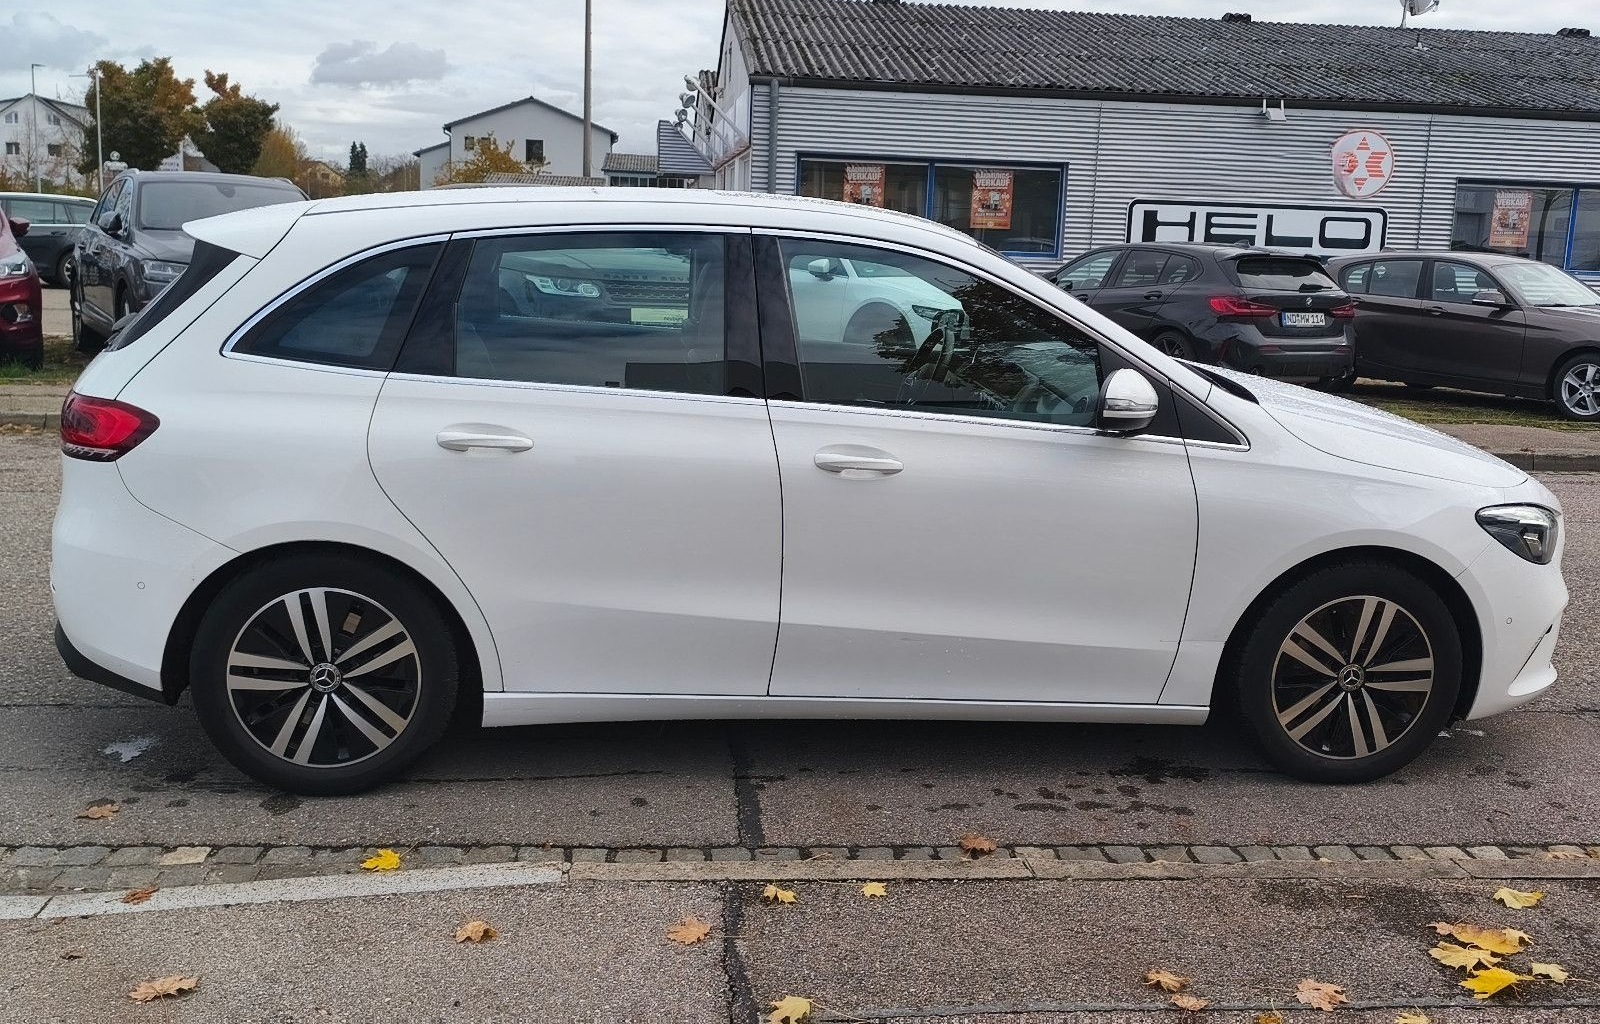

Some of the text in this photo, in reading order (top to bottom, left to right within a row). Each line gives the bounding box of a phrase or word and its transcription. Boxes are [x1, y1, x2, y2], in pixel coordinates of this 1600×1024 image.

[847, 172, 882, 181] VERKAUF
[976, 178, 1010, 187] VERKAUF
[1496, 198, 1529, 207] VERKAUF
[1141, 209, 1372, 250] HELO
[1310, 314, 1324, 324] 114
